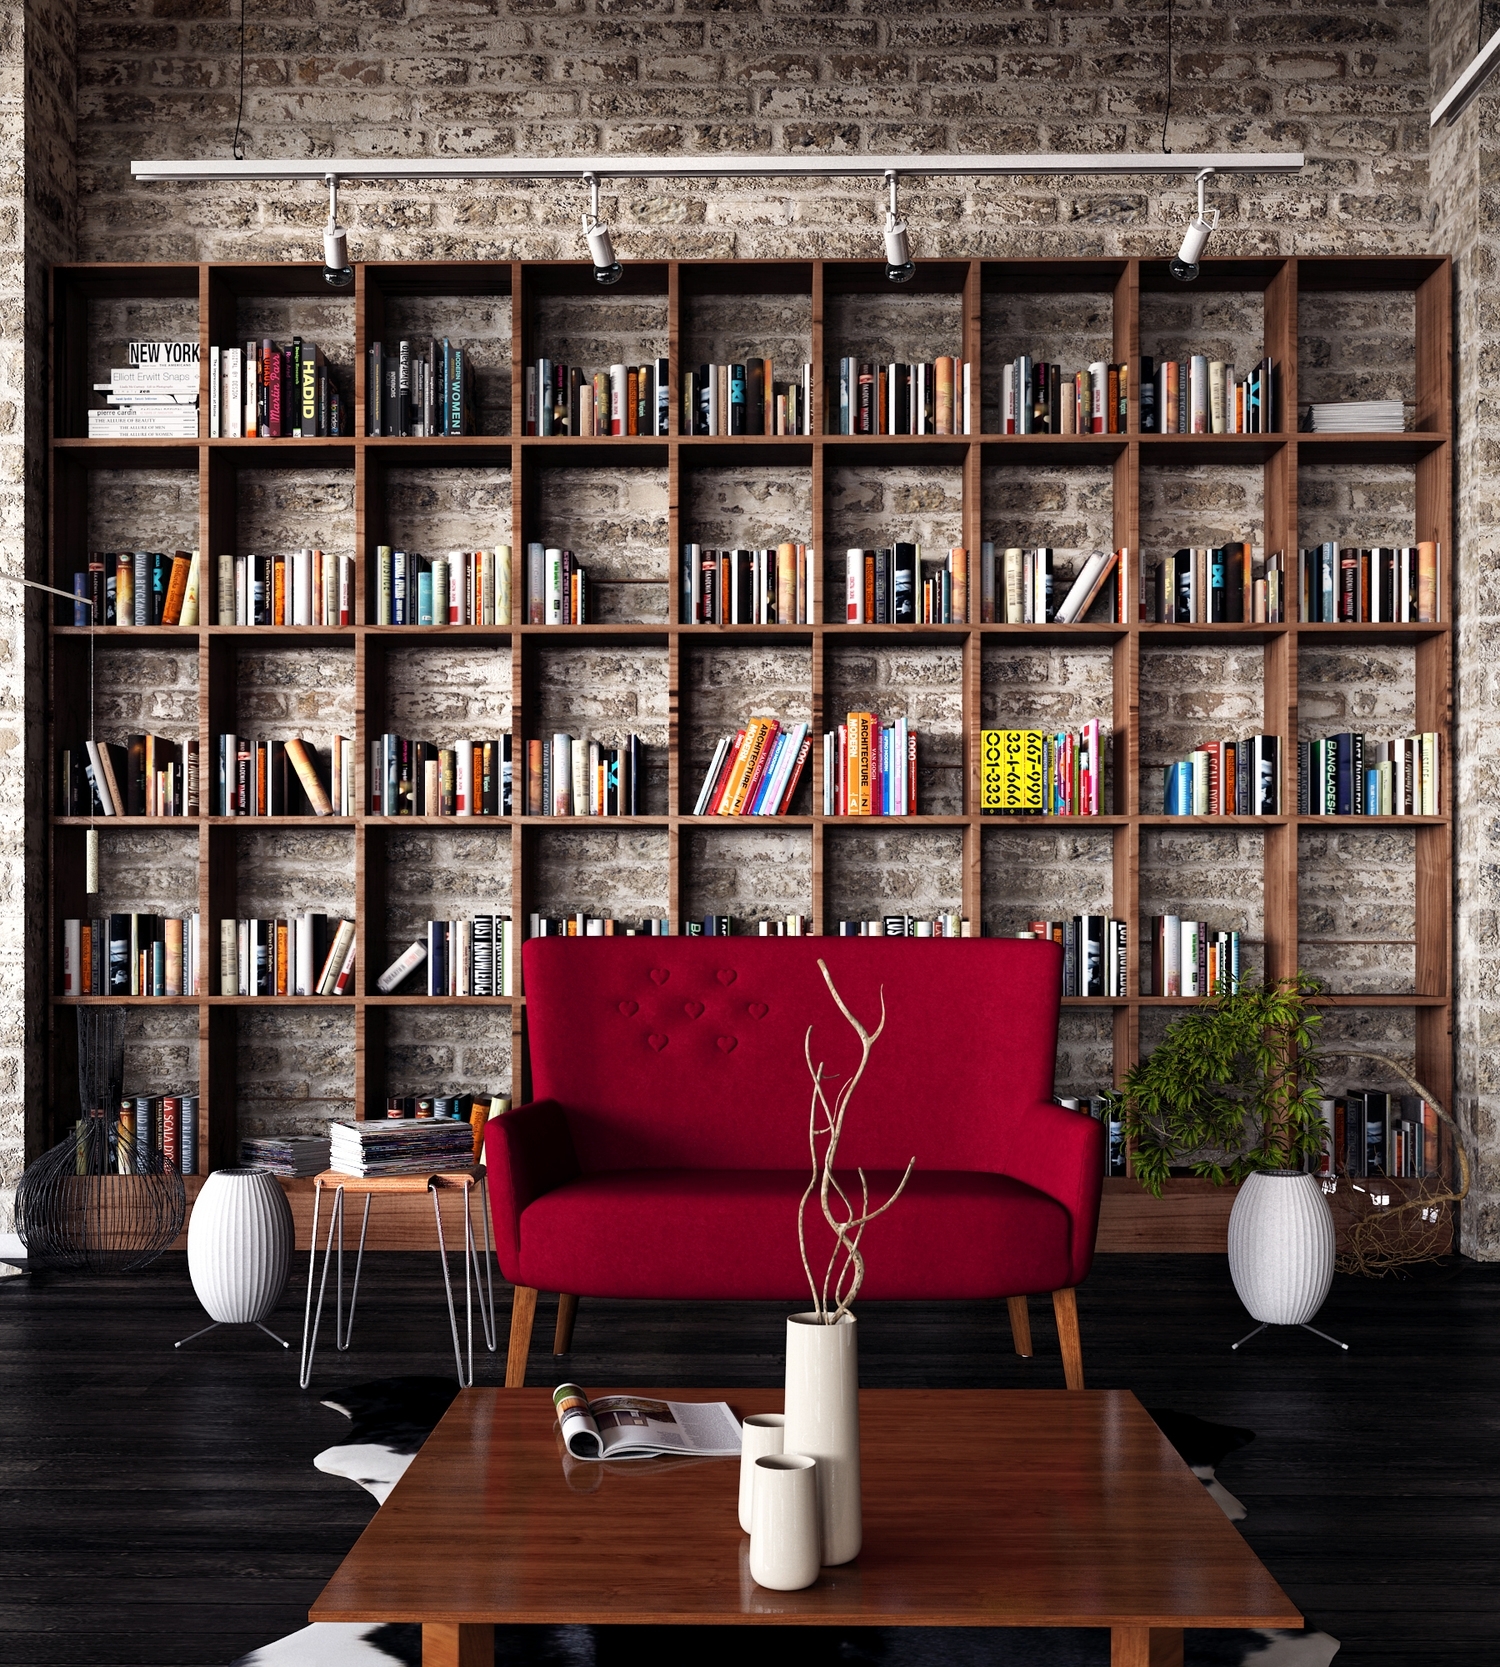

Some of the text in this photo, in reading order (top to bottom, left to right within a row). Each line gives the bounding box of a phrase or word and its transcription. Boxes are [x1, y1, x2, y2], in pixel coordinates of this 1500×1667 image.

[113, 372, 190, 382] Elliott Erwitt Snaps
[130, 343, 200, 362] NEW YORK
[270, 354, 280, 422] Martin Parr
[303, 360, 315, 419] HADID
[452, 381, 460, 428] WOMEN
[739, 723, 758, 762] MODERN
[742, 723, 768, 789] ARCHITECTURE
[797, 740, 810, 764] 1000
[986, 732, 1000, 805] 001-333
[1007, 733, 1020, 805] 334-666
[1027, 733, 1041, 805] 667-999
[1327, 740, 1337, 815] BANGLADESH
[474, 918, 492, 995] LOST KNOWLEDGE
[887, 919, 903, 936] LOS
[164, 1100, 174, 1111] LA
[164, 1114, 174, 1142] SCALA
[182, 1100, 191, 1174] DAVID BLACKWOOD
